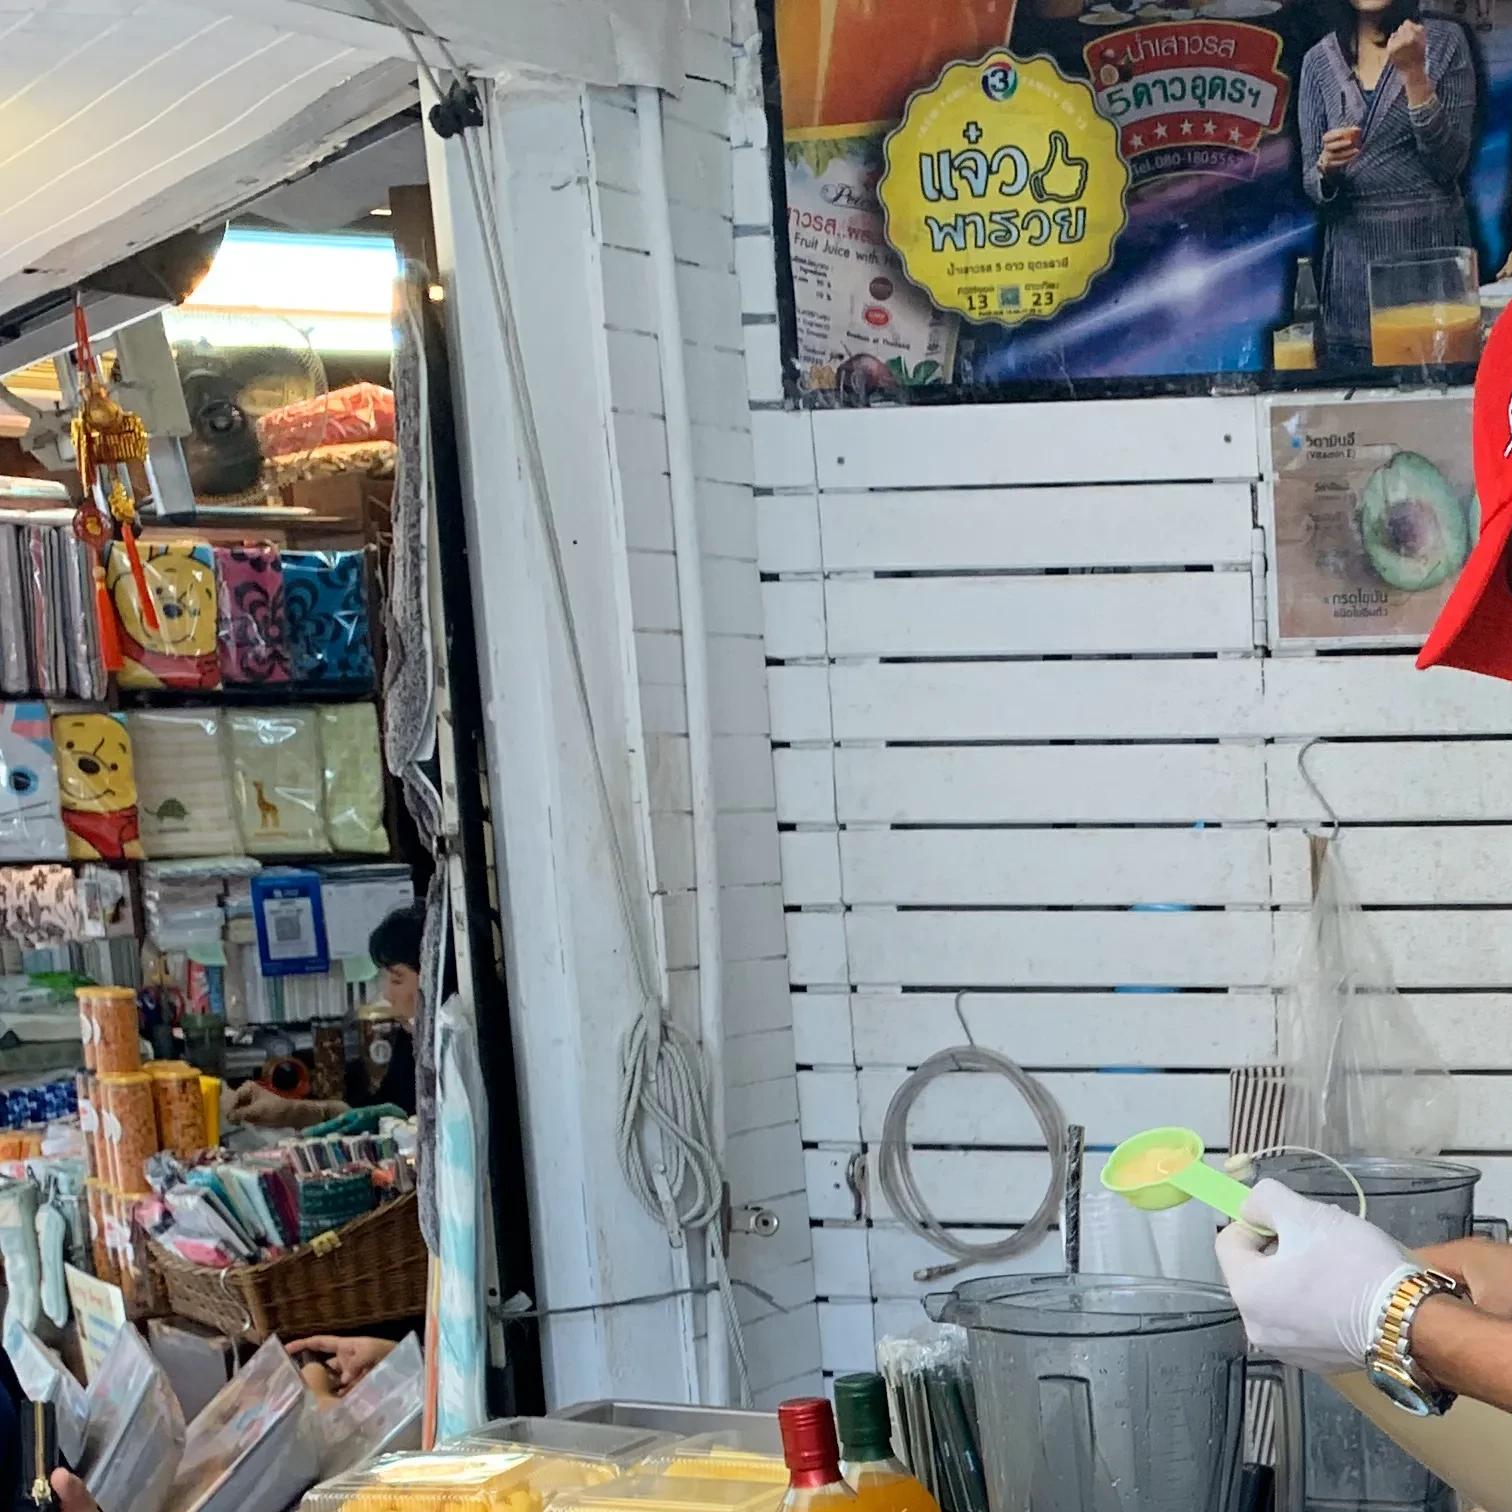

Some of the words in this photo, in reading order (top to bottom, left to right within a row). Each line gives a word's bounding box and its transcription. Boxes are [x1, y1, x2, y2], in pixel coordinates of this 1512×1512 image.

[918, 120, 1030, 203] แจ๋ว
[925, 205, 1087, 252] พารวย
[794, 231, 819, 250] Fruit
[822, 238, 850, 259] Juice
[856, 247, 880, 265] with
[967, 295, 989, 311] 13
[1032, 291, 1054, 307] 23
